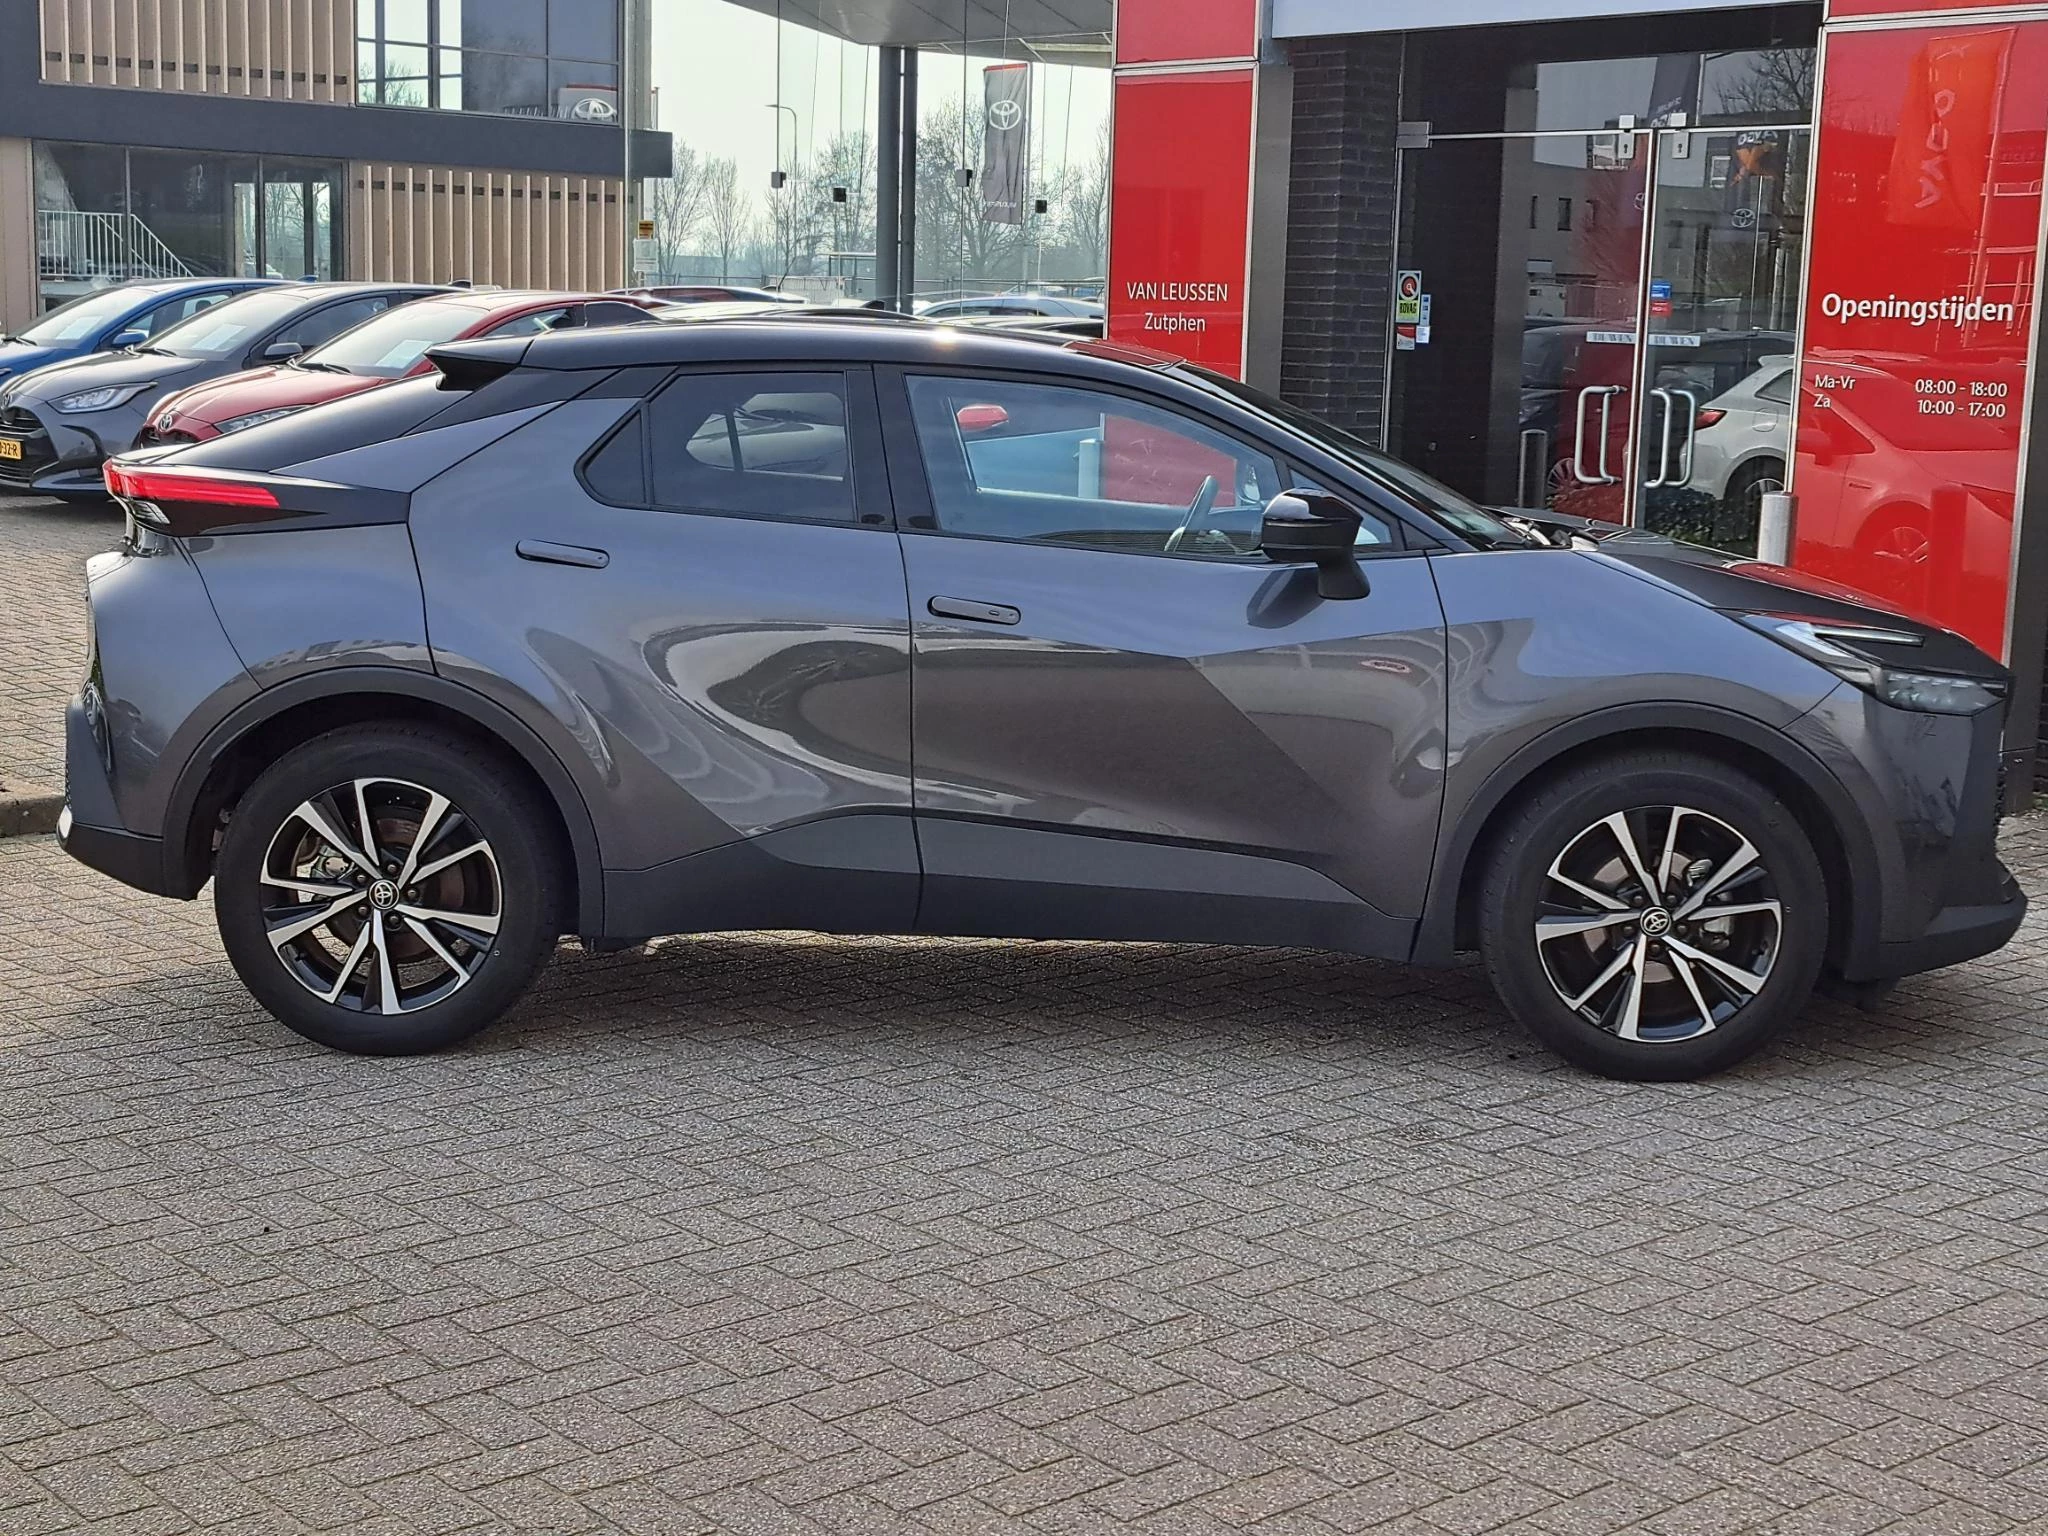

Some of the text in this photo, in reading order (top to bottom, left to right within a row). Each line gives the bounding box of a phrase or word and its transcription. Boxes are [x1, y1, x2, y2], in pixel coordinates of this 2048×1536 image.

[1127, 282, 1228, 302] VAN LEUSSEN
[1822, 293, 2013, 327] Openingstijden
[1144, 312, 1206, 334] Zutphen
[1814, 374, 1855, 390] Ma-Vr
[1915, 379, 1956, 394] 08:00
[1969, 382, 2008, 397] 18:00
[1814, 394, 1831, 408] Za
[1917, 399, 1955, 415] 10:00
[1968, 402, 2006, 418] 17:00
